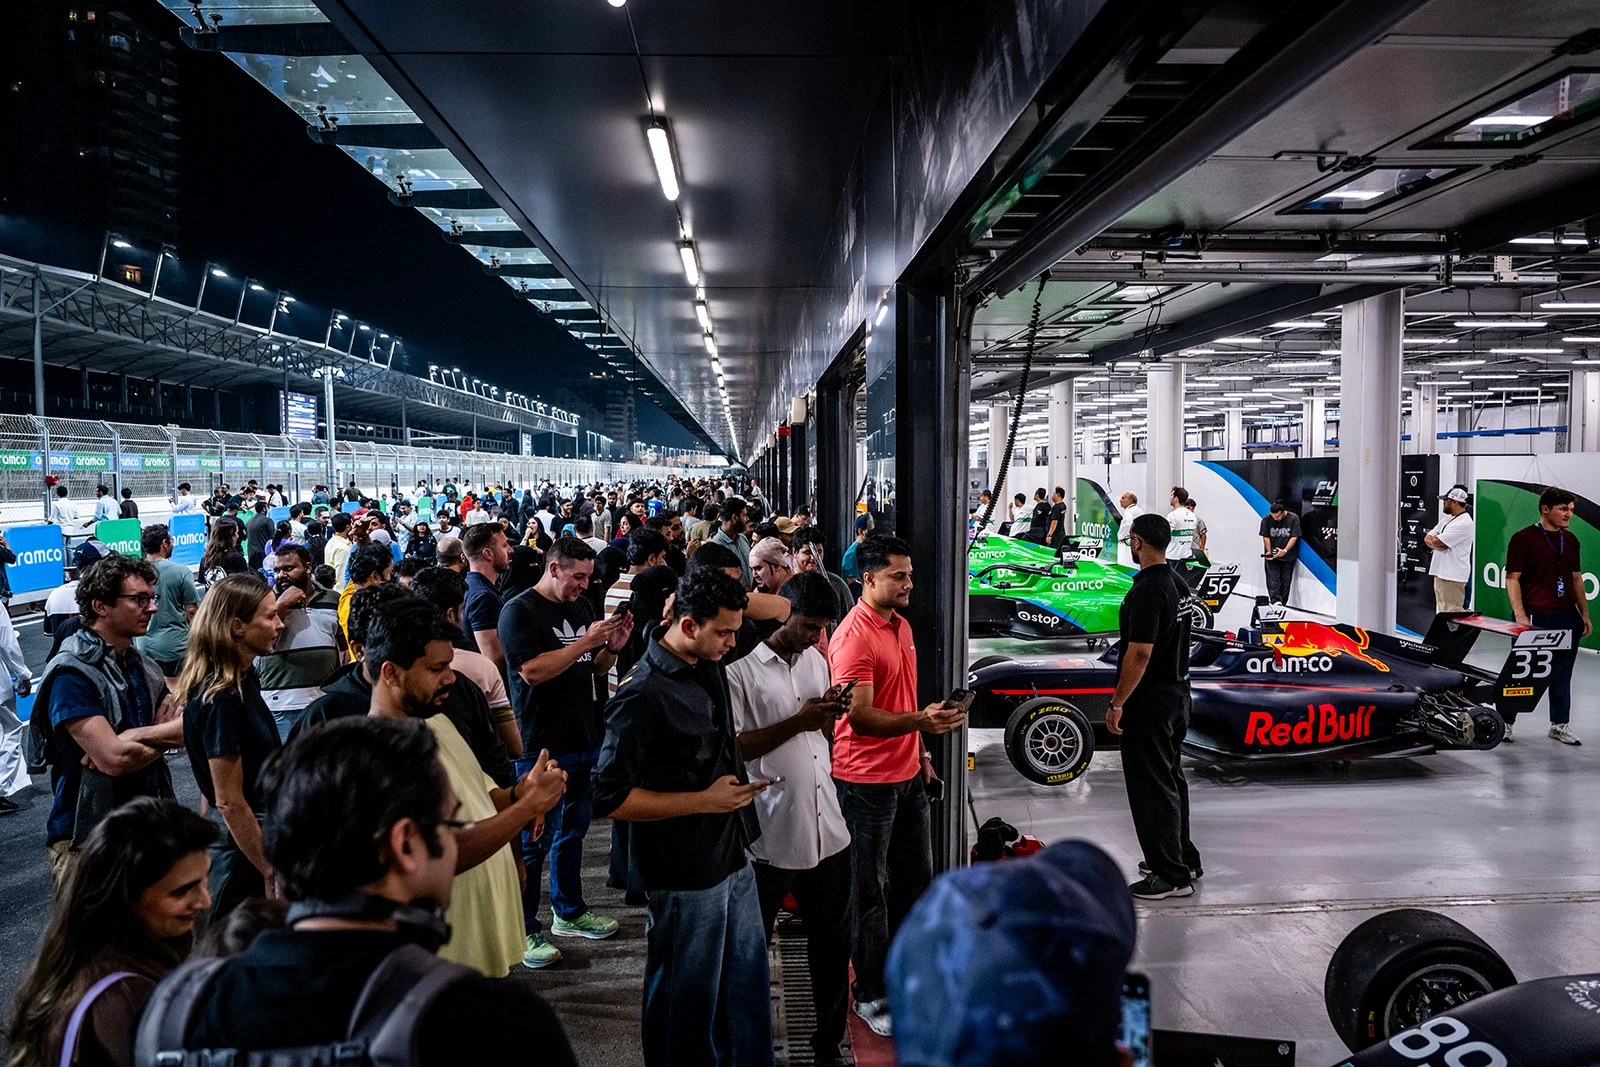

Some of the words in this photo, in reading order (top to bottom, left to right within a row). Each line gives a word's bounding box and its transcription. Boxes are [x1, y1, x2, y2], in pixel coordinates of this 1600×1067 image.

[0, 456, 27, 465] amco
[35, 456, 70, 466] amco
[76, 456, 106, 466] aramco
[120, 458, 139, 466] amco
[1315, 481, 1337, 496] F4
[172, 533, 205, 547] aramco
[8, 548, 62, 568] ramco
[968, 550, 1006, 559] aramco
[1052, 580, 1104, 592] aramco
[1206, 577, 1232, 595] 56
[1246, 656, 1333, 673] aramco
[1511, 650, 1553, 679] 33
[1244, 703, 1315, 746] Red
[1317, 702, 1377, 743] Bull
